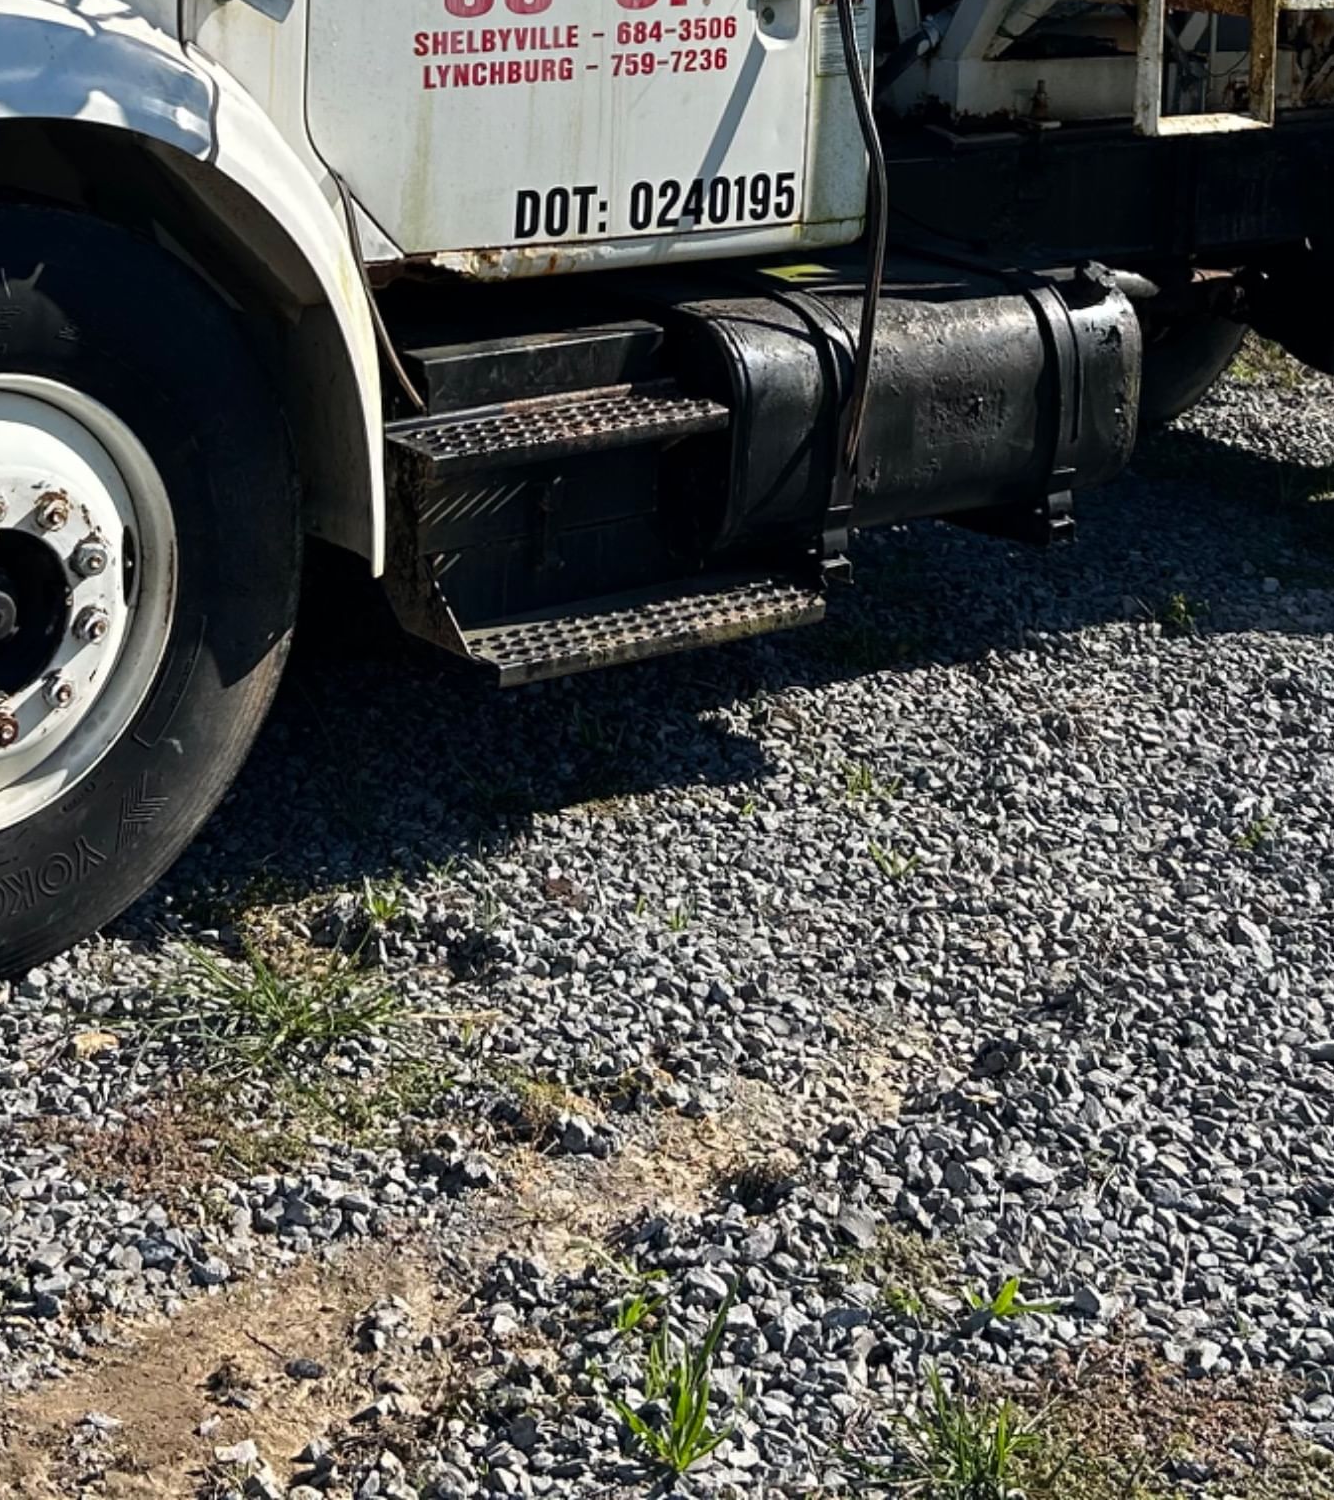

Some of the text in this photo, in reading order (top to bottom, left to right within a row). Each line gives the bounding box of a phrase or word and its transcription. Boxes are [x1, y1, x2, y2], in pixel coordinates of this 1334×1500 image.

[413, 24, 580, 57] SHELBYVILLE
[616, 15, 737, 45] 684-3506
[422, 56, 574, 90] LYNCHBURG
[611, 46, 729, 77] 759-7236
[514, 171, 796, 240] DOT: 0240195
